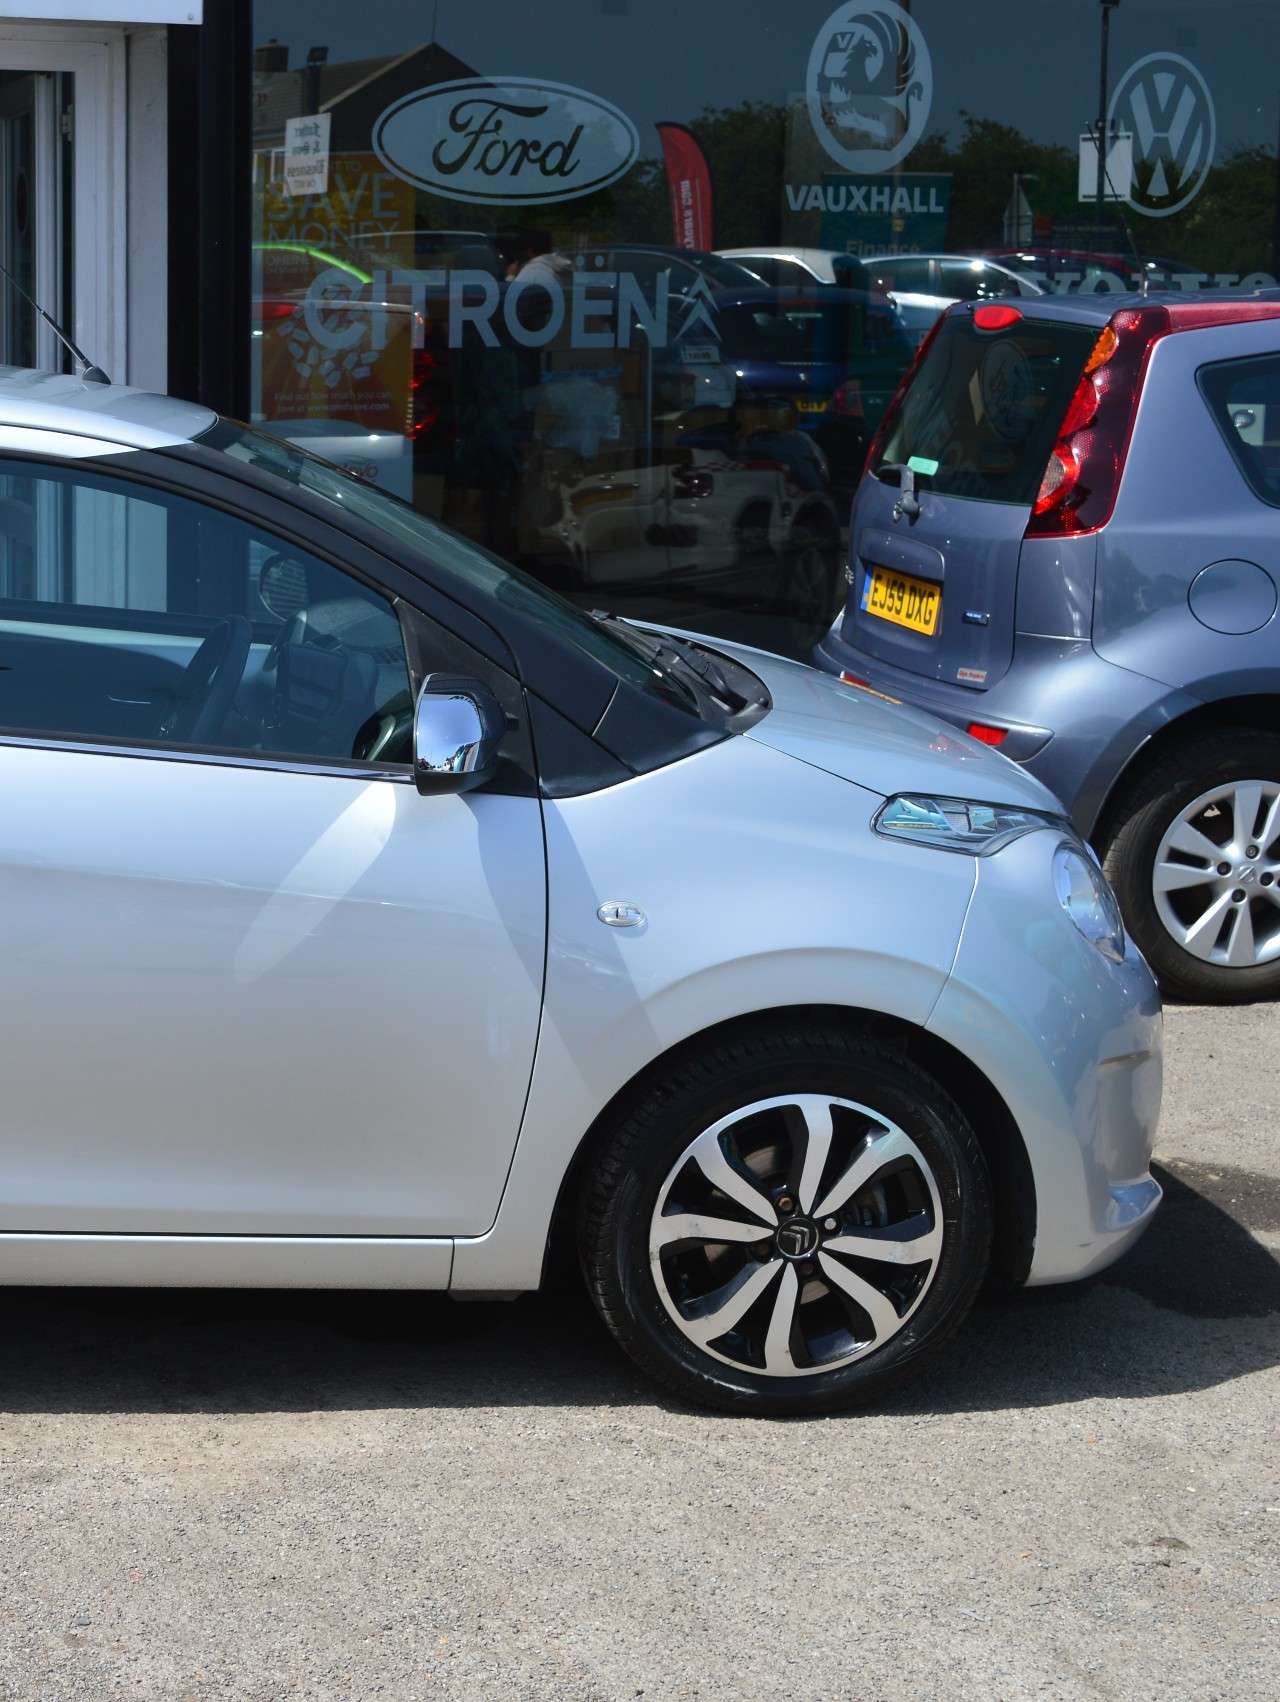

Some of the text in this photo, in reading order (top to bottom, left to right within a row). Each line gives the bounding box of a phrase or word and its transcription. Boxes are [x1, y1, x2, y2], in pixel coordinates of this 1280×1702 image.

[432, 98, 584, 177] Ford
[785, 184, 944, 214] VAUXHALL
[304, 255, 669, 349] CITROËN
[871, 574, 935, 626] EJ59 DXG
